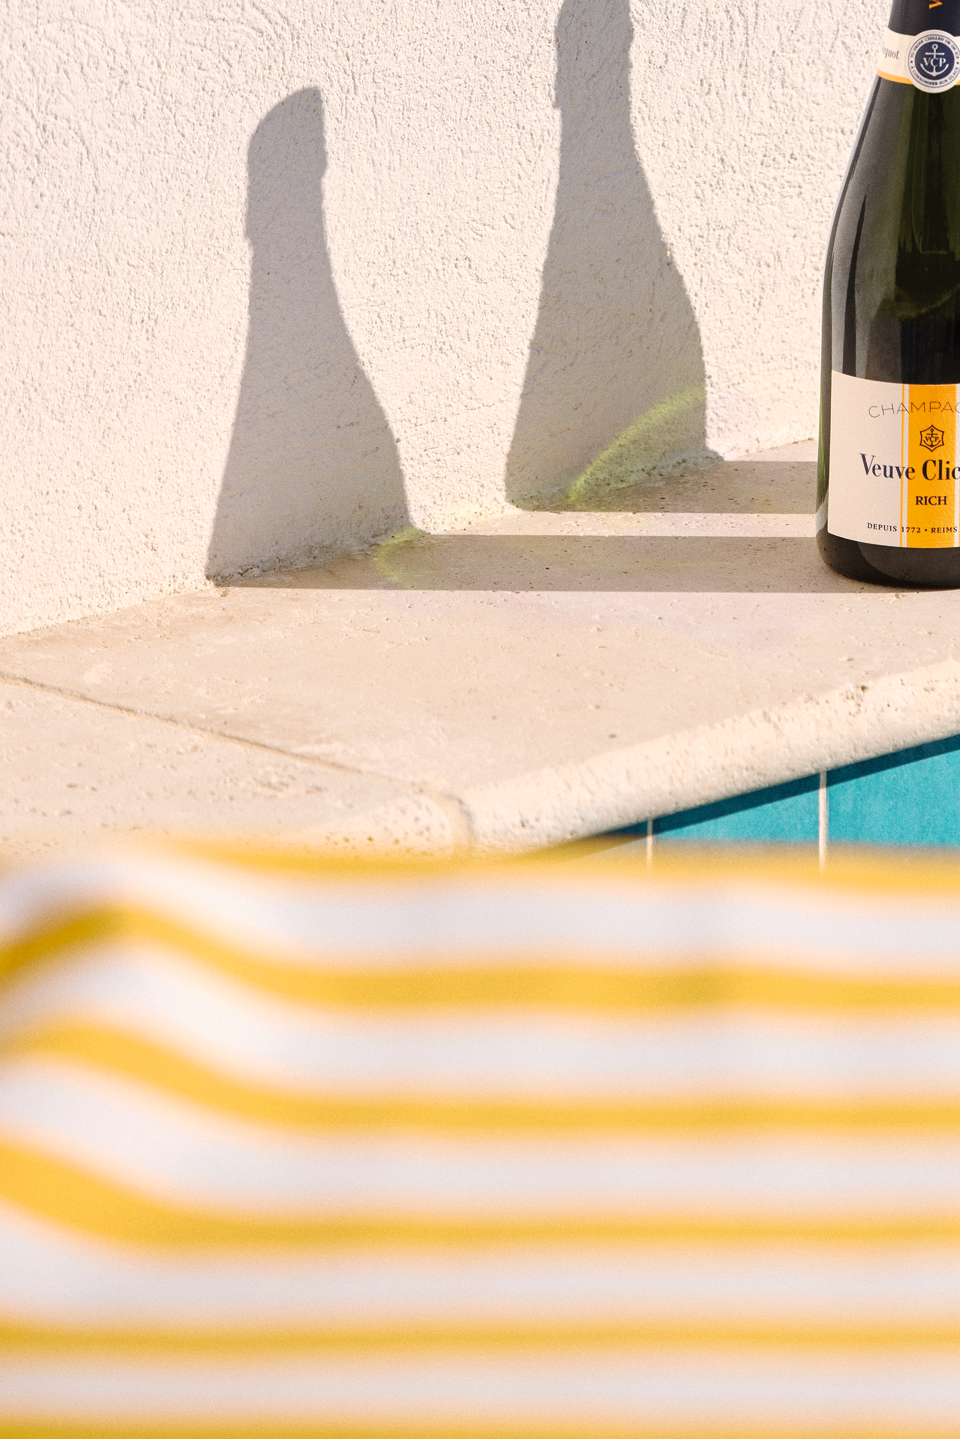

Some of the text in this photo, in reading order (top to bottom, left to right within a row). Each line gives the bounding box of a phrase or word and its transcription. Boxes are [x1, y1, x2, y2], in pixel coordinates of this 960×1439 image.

[923, 57, 946, 67] VCP
[859, 452, 916, 481] Veuve
[915, 495, 948, 506] RICH
[867, 522, 897, 533] DEPUIS
[901, 526, 921, 534] 1772
[931, 526, 958, 534] REIMS
